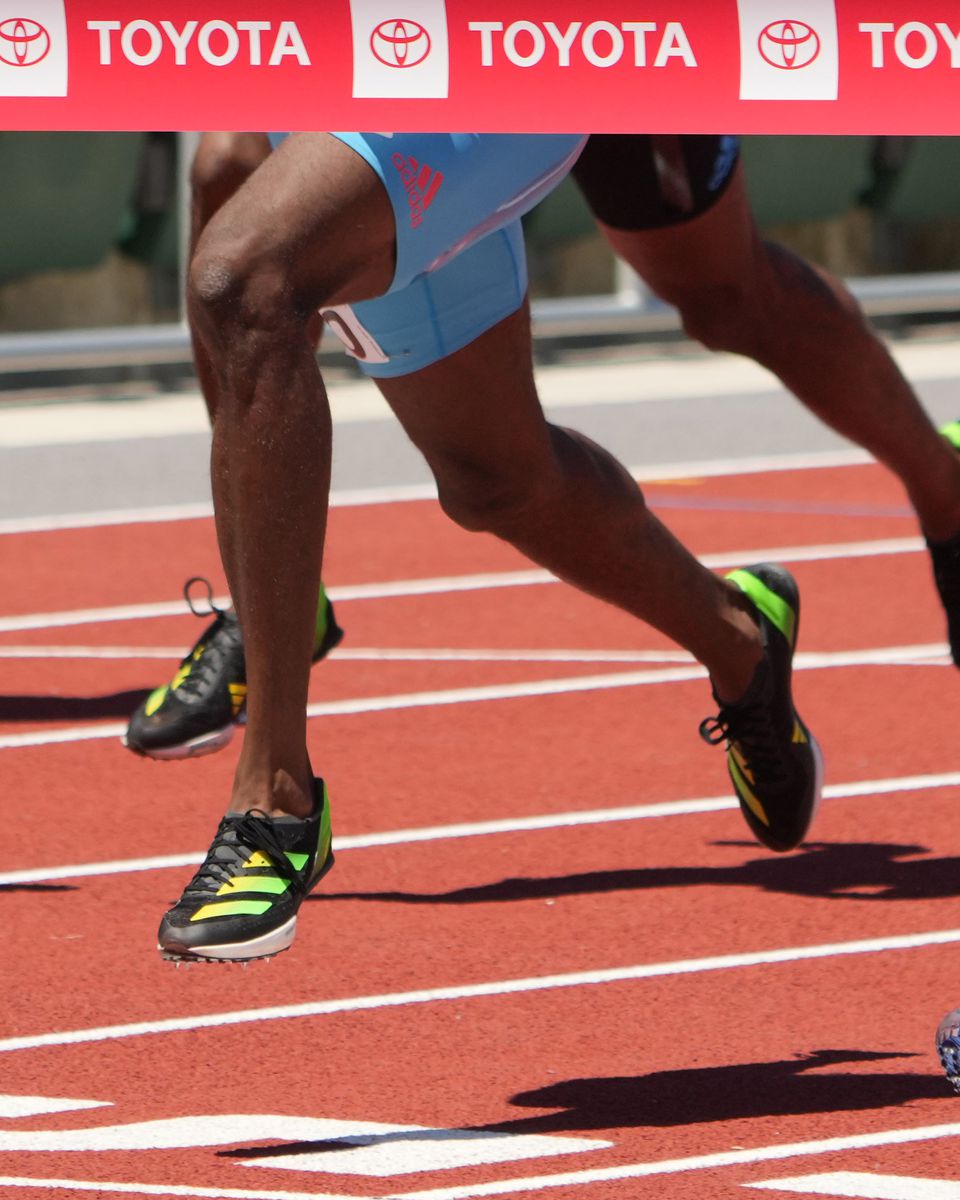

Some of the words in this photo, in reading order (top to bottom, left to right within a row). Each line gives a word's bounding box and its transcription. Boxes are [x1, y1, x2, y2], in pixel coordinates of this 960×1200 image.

[87, 19, 312, 67] TOYOTA
[468, 20, 698, 68] TOYOTA
[858, 21, 960, 69] TOY
[392, 152, 424, 230] adidas
